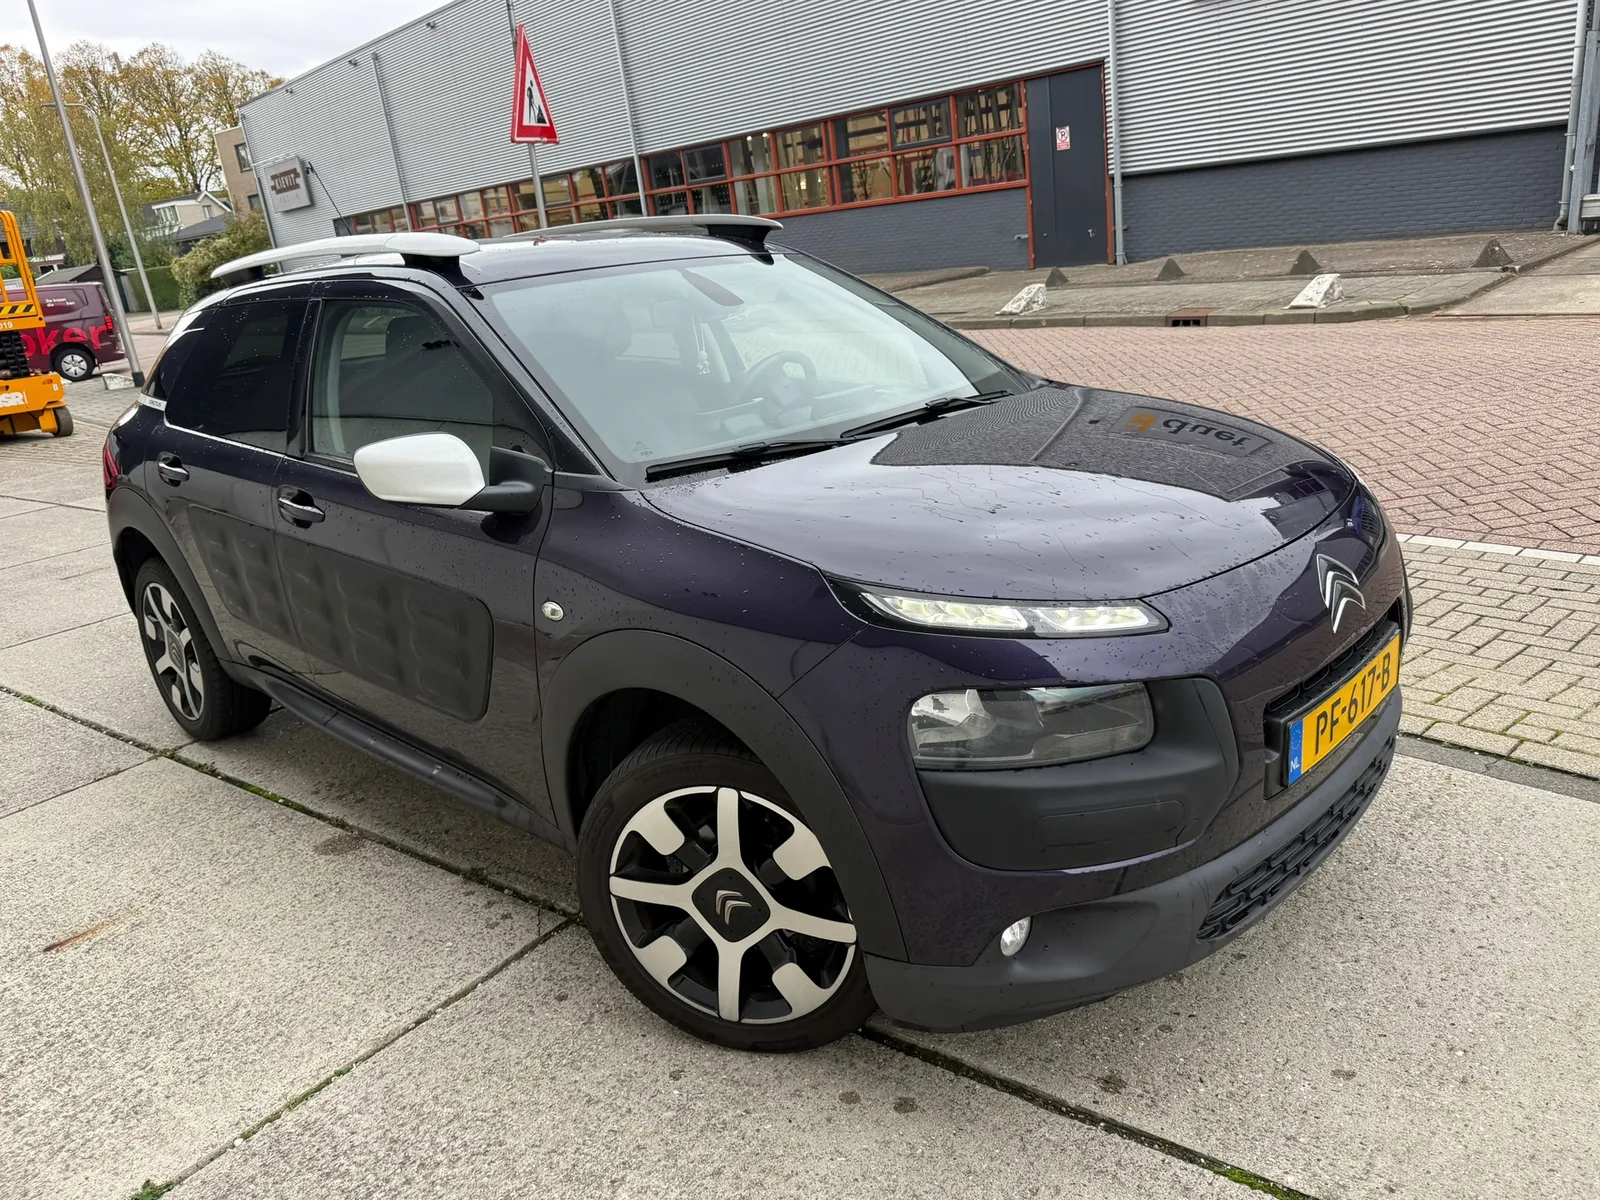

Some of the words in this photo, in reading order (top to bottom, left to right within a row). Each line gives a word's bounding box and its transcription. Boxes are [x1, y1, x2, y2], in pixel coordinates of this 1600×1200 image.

[275, 174, 295, 188] KIEVIT
[1315, 652, 1391, 755] PF-617-B
[1290, 756, 1300, 772] NL
